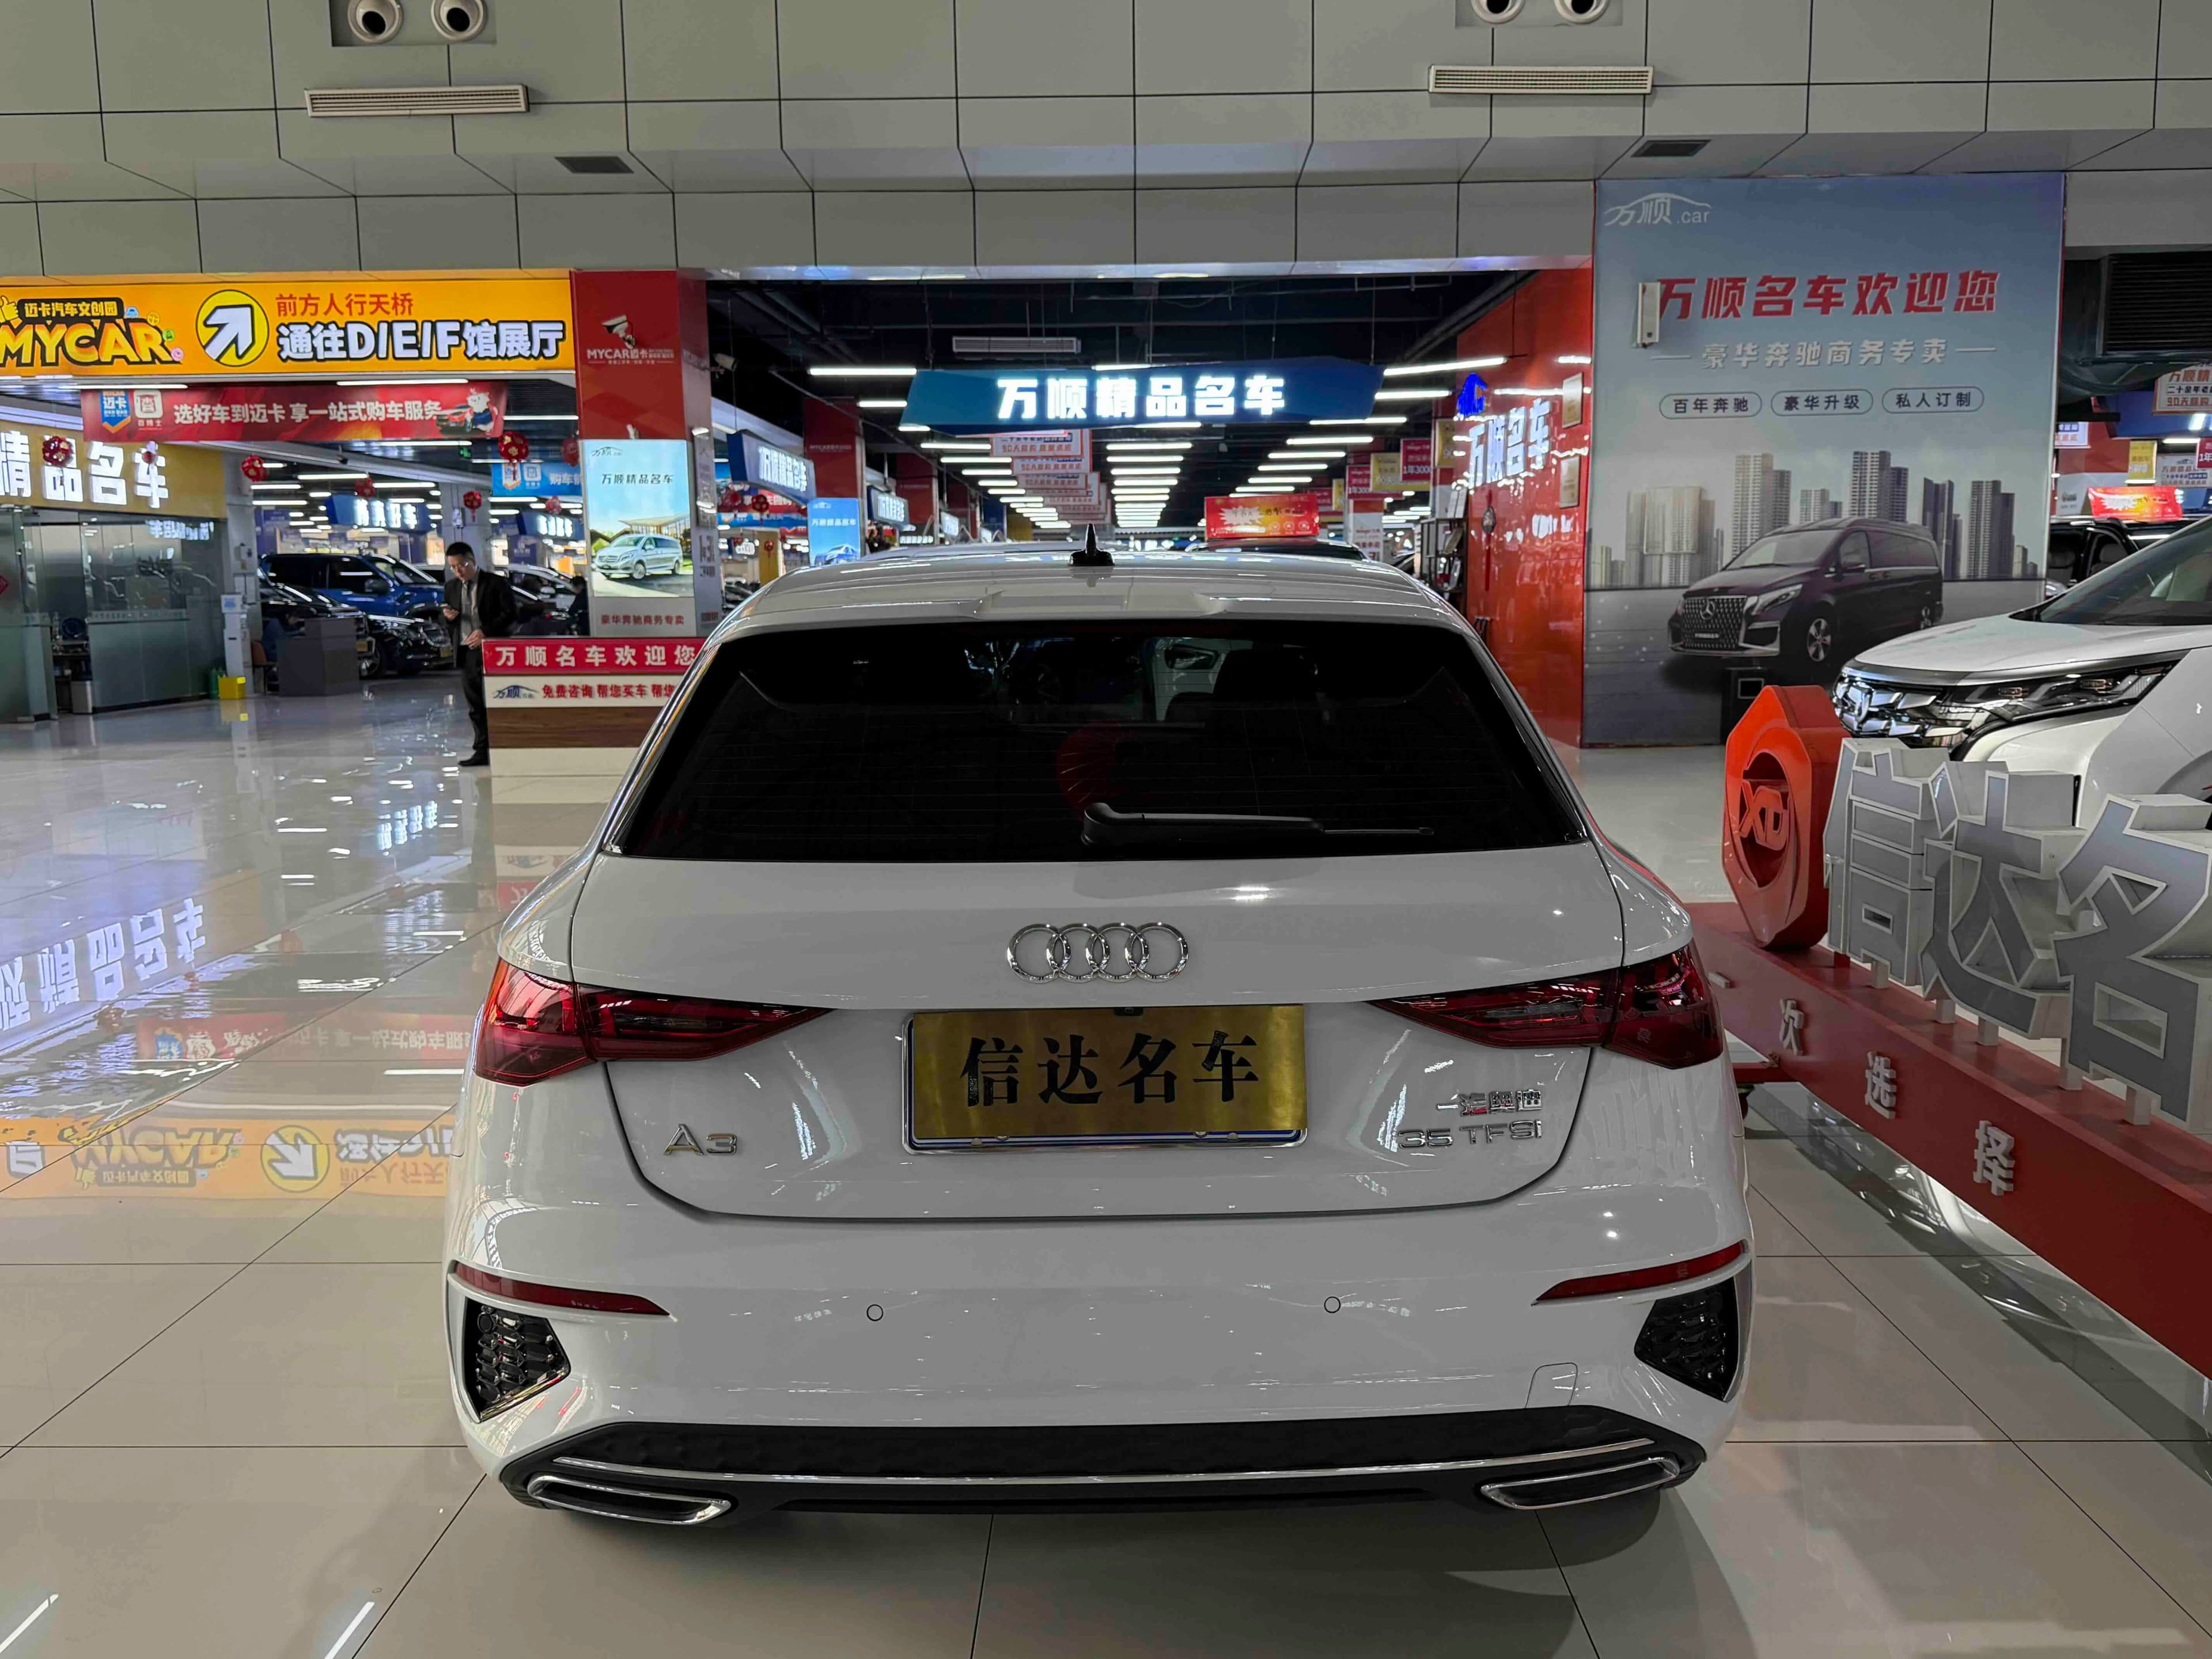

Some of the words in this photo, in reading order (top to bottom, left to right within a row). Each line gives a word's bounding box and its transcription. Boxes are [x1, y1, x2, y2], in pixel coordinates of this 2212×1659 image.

[276, 293, 414, 317] 前方人行天桥
[1656, 270, 1999, 320] 万顺名车欢迎您
[24, 301, 119, 318] 迈卡汽车文创园
[0, 320, 180, 366] MYCAR
[276, 320, 566, 362] 通往D/E/F馆展厅
[1702, 338, 1948, 369] 豪华奔驰商务专卖
[997, 375, 1285, 419] 万顺精品名车
[1672, 397, 1749, 414] 百年奔驰
[1784, 395, 1861, 411] 豪华升级
[1896, 392, 1971, 408] 私人订制
[174, 403, 286, 425] 选好车到迈卡
[290, 400, 444, 422] 享一站式购车服务
[1469, 398, 1551, 488] 万顺名车
[0, 430, 169, 509] 精品名车
[602, 474, 674, 484] 万顺精品名车
[601, 615, 684, 626] 豪华奔驰商务专卖
[495, 645, 695, 668] 万顺名车欢迎您
[542, 684, 593, 699] 免费咨询
[597, 684, 647, 699] 帮您买车
[960, 1030, 1259, 1107] 信达名车
[663, 1123, 738, 1156] A3
[1399, 1128, 1453, 1148] 35
[1459, 1120, 1543, 1144] TFSI
